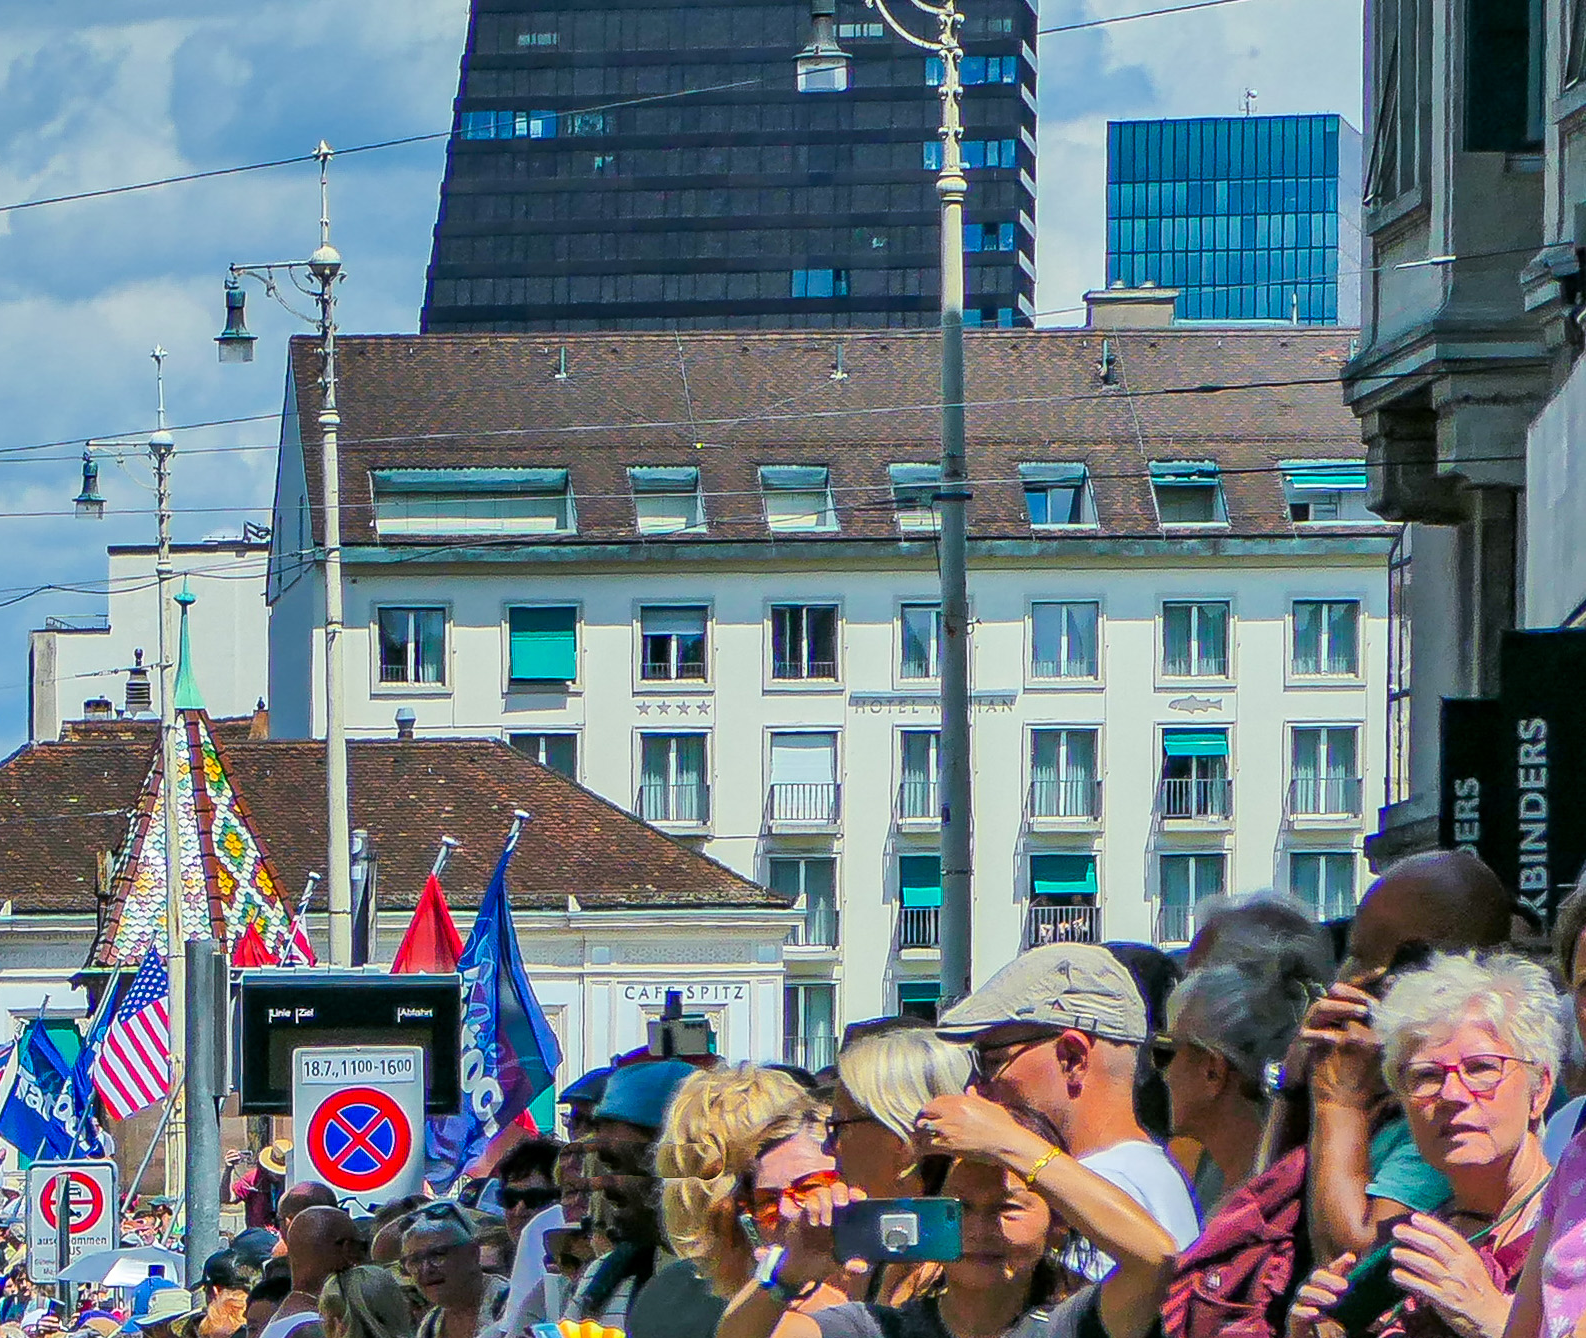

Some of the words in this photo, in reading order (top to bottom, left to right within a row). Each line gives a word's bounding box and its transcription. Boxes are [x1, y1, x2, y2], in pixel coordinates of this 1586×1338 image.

[855, 700, 919, 714] HOTEL
[624, 985, 675, 1000] CAF
[687, 985, 744, 1000] SPITZ
